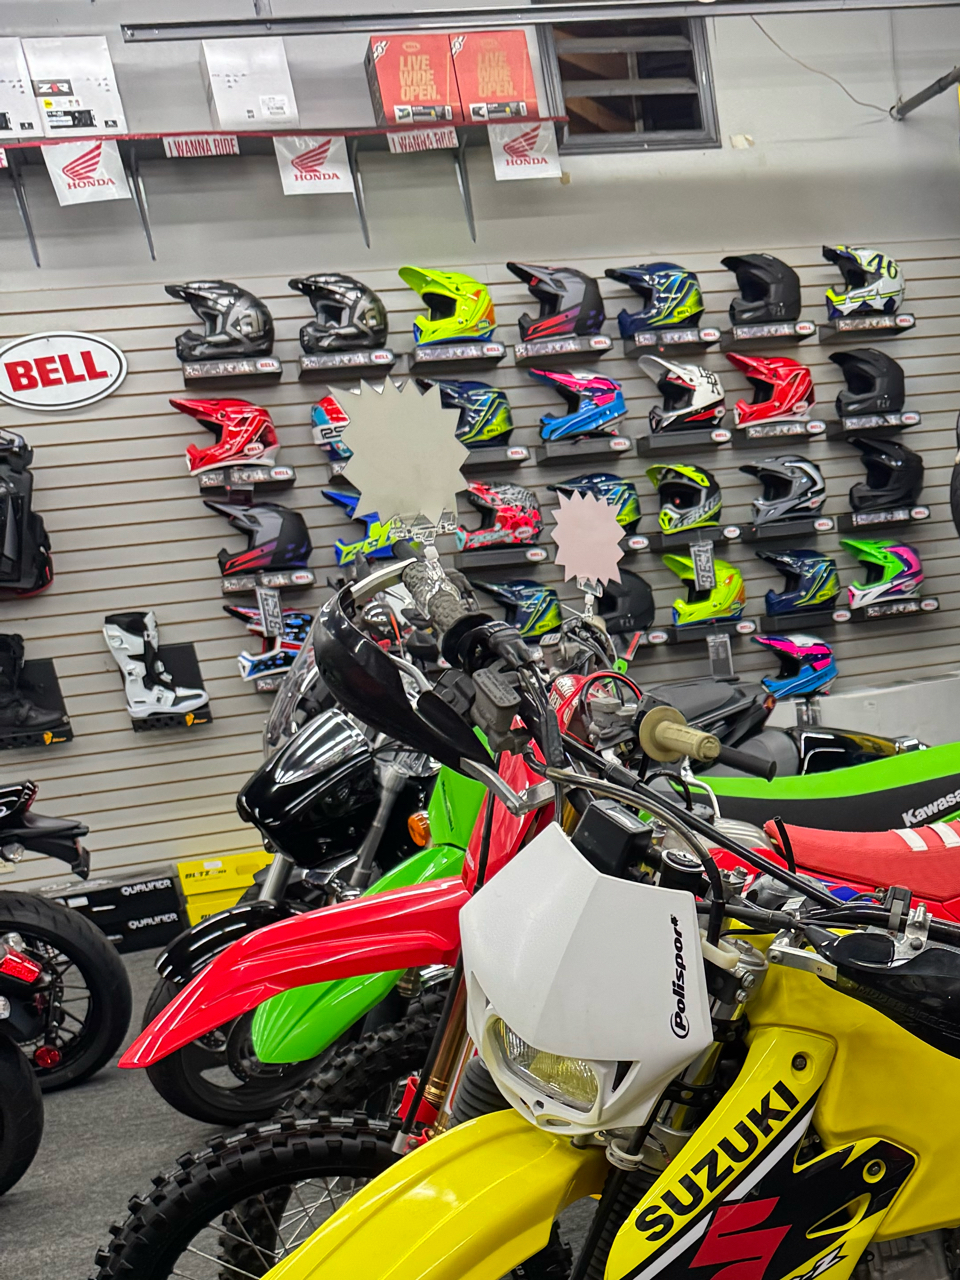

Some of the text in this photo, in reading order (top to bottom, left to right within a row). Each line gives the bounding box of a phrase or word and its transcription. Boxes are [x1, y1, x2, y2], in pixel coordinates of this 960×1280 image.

[400, 55, 430, 71] LIVE
[478, 52, 508, 68] LIVE
[400, 70, 434, 86] WIDE
[478, 67, 511, 83] WIDE
[401, 84, 441, 102] OPEN.
[478, 81, 517, 98] OPEN.
[176, 139, 212, 157] WANNA
[213, 137, 237, 155] RIDE
[399, 133, 432, 153] WANNA
[434, 130, 458, 149] RIDE
[505, 157, 549, 166] HONDA
[67, 177, 116, 190] HONDA
[294, 172, 341, 182] HONDA
[866, 252, 899, 280] 46
[4, 350, 109, 392] BELL
[670, 913, 690, 1040] Polisport
[635, 1080, 800, 1243] SUZUKI
